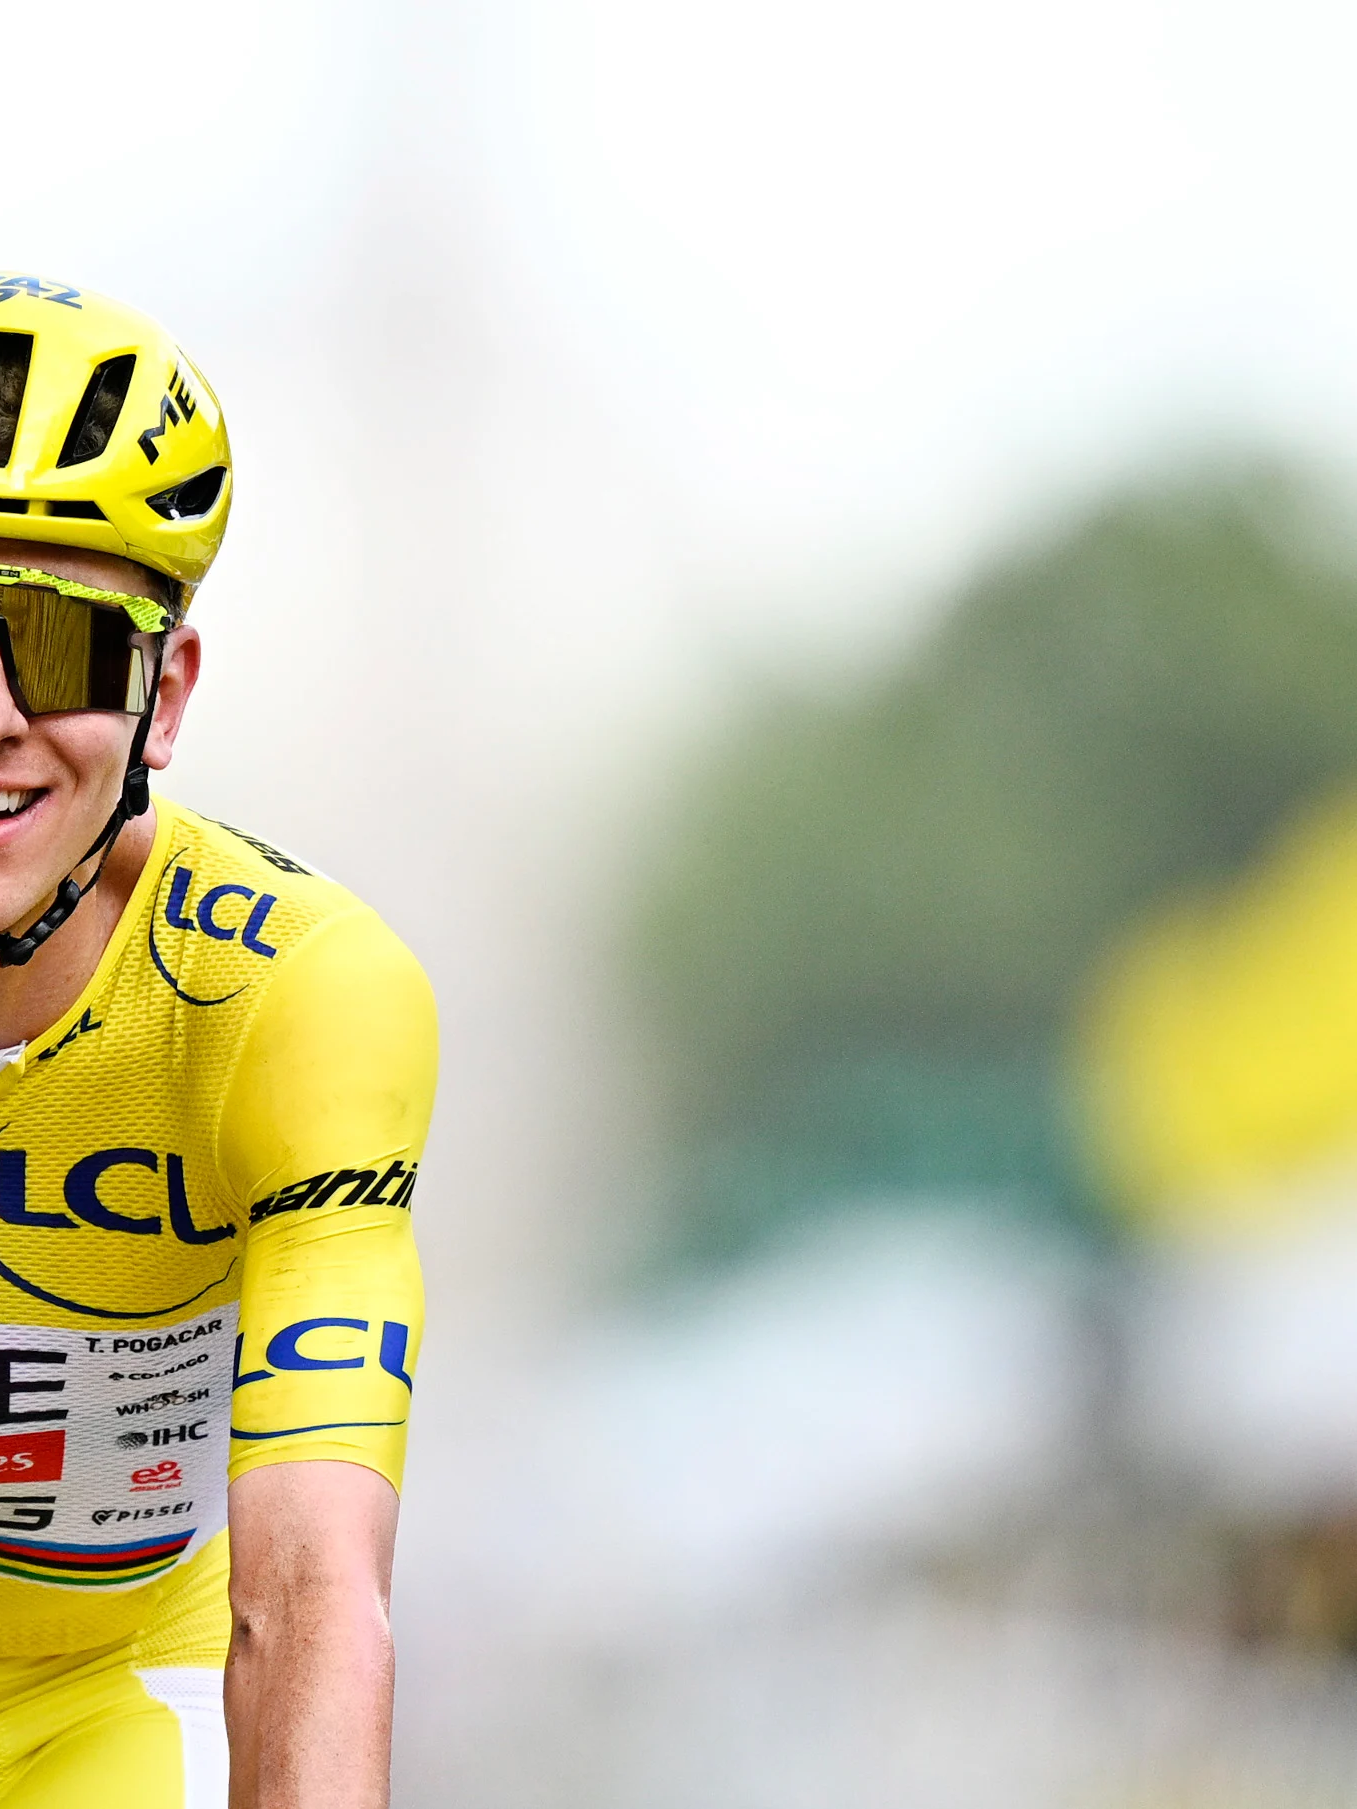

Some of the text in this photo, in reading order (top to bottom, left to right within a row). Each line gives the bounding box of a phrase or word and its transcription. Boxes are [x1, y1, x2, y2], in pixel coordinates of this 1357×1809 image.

[164, 866, 277, 959] LCL
[85, 1319, 222, 1353] T. POGACAR
[232, 1318, 412, 1397] LCL
[152, 1420, 208, 1446] IHC
[117, 1501, 193, 1522] PISSEI
